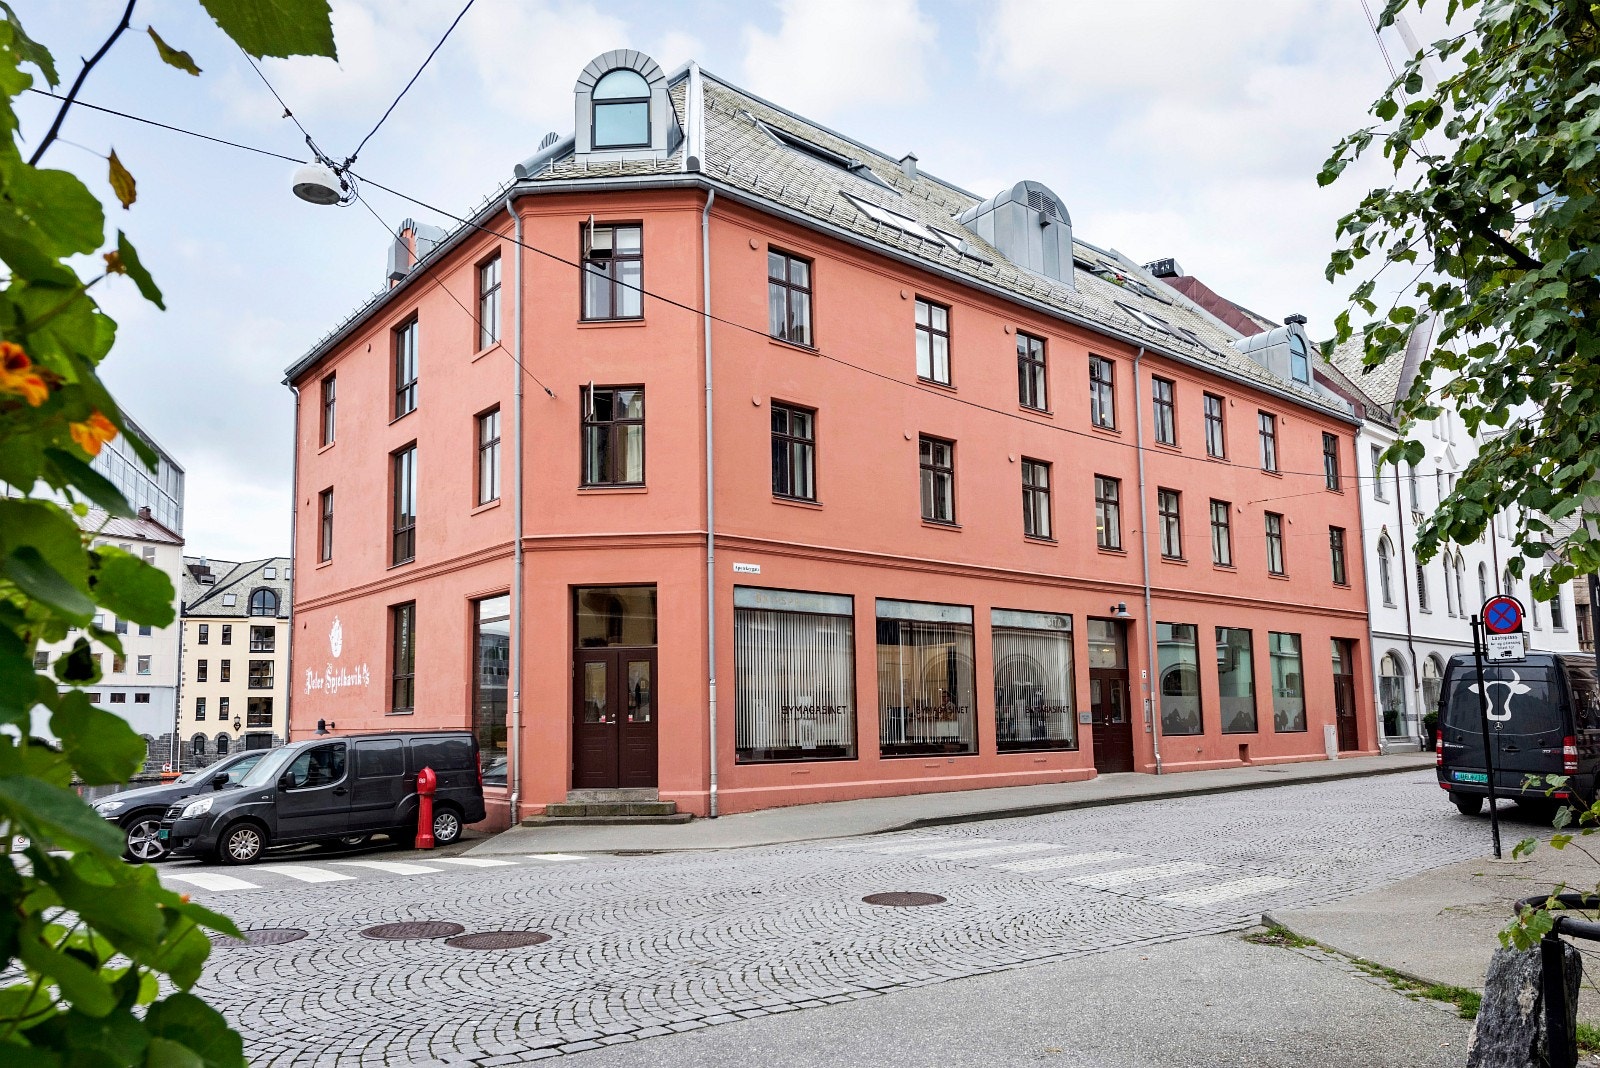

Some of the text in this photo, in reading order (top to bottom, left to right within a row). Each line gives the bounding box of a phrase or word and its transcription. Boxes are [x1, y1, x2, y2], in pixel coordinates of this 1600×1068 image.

[304, 666, 324, 695] Peter
[325, 663, 361, 695] Spjelkavik
[781, 705, 847, 715] BYMAGASINET
